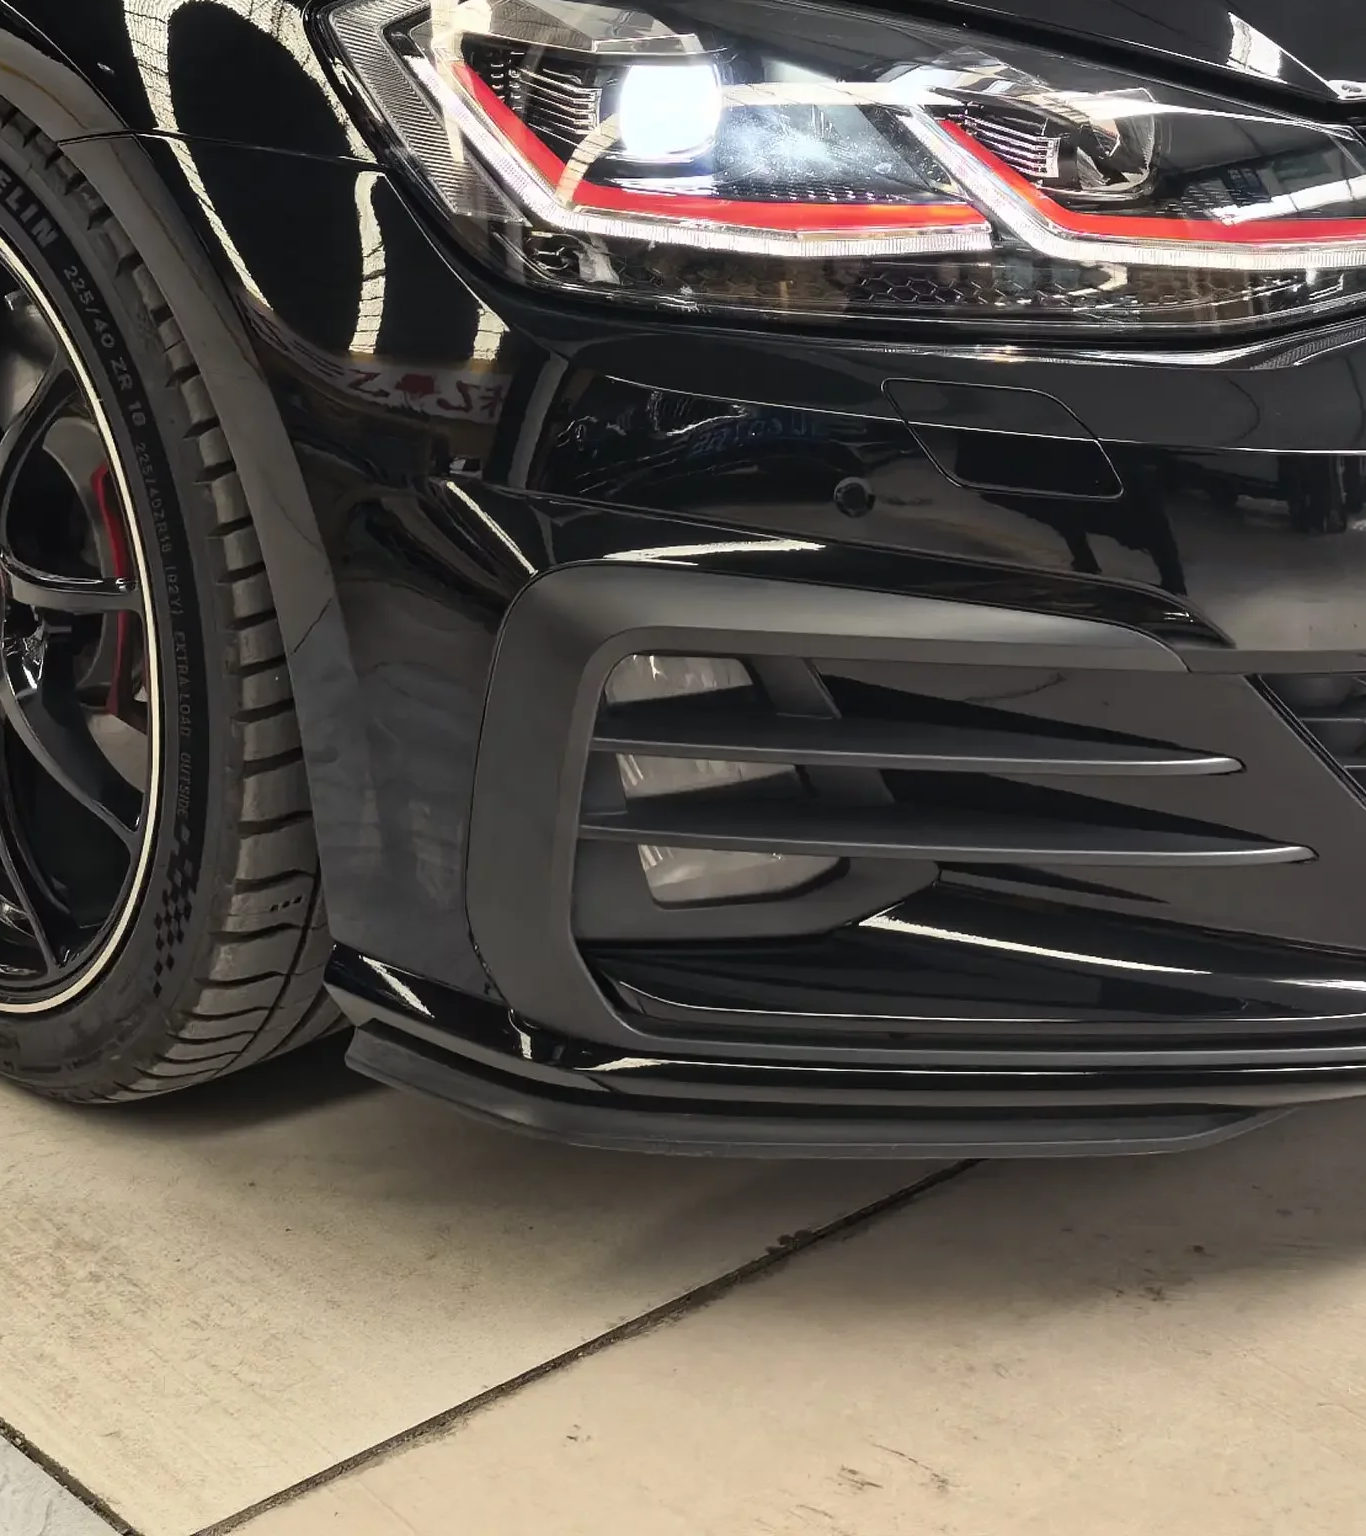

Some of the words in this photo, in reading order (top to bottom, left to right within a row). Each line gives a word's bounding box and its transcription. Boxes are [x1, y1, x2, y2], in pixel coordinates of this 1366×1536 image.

[63, 264, 115, 349] 225/40
[110, 357, 133, 391] ZR
[174, 630, 191, 684] EXTRA
[178, 692, 192, 736] LOAD
[176, 751, 192, 818] OUTSIDE
